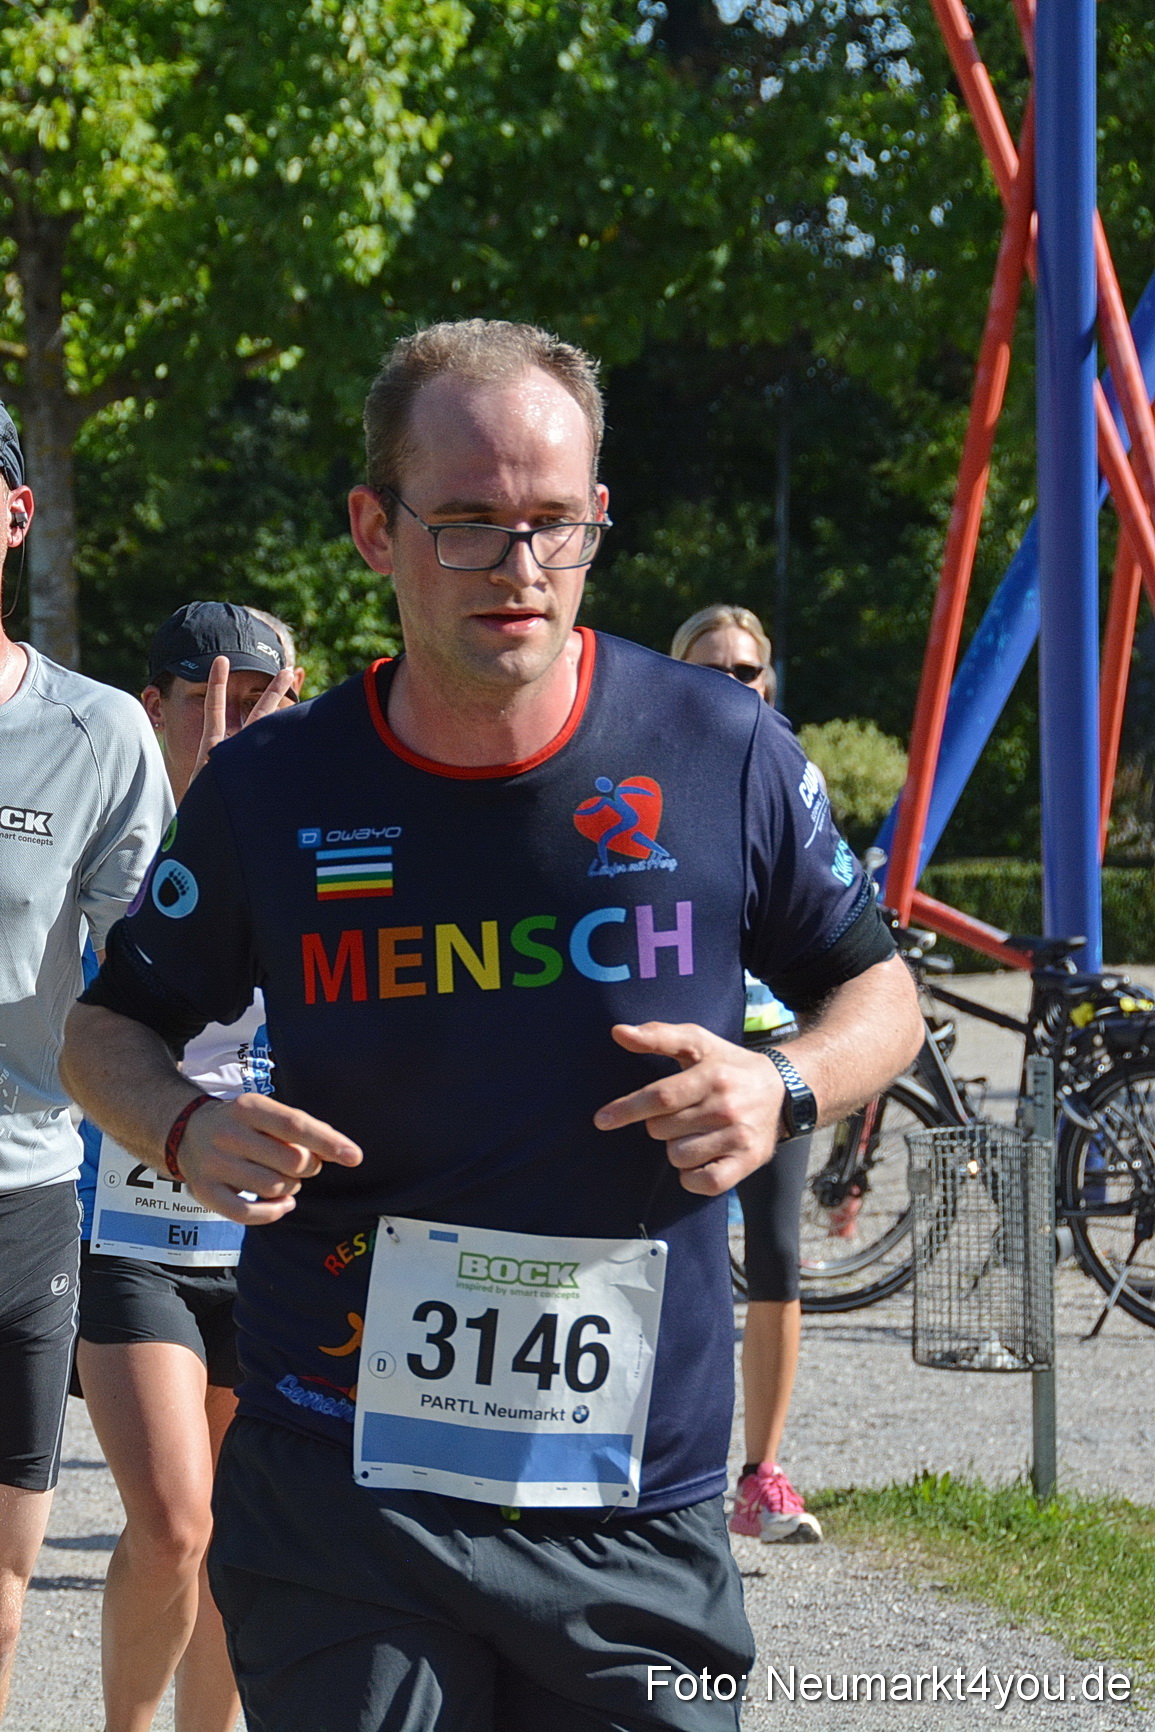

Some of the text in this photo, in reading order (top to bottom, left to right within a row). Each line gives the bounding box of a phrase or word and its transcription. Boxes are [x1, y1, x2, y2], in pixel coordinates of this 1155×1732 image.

[18, 835, 54, 846] concepts
[302, 901, 694, 1005] MENSCH
[135, 1197, 170, 1211] PARTL
[168, 1224, 199, 1246] Evi
[458, 1250, 581, 1289] BOCK
[456, 1281, 581, 1300] inspired by smart concepts
[406, 1299, 612, 1393] 3146
[420, 1394, 566, 1421] PARTL Neumarkt
